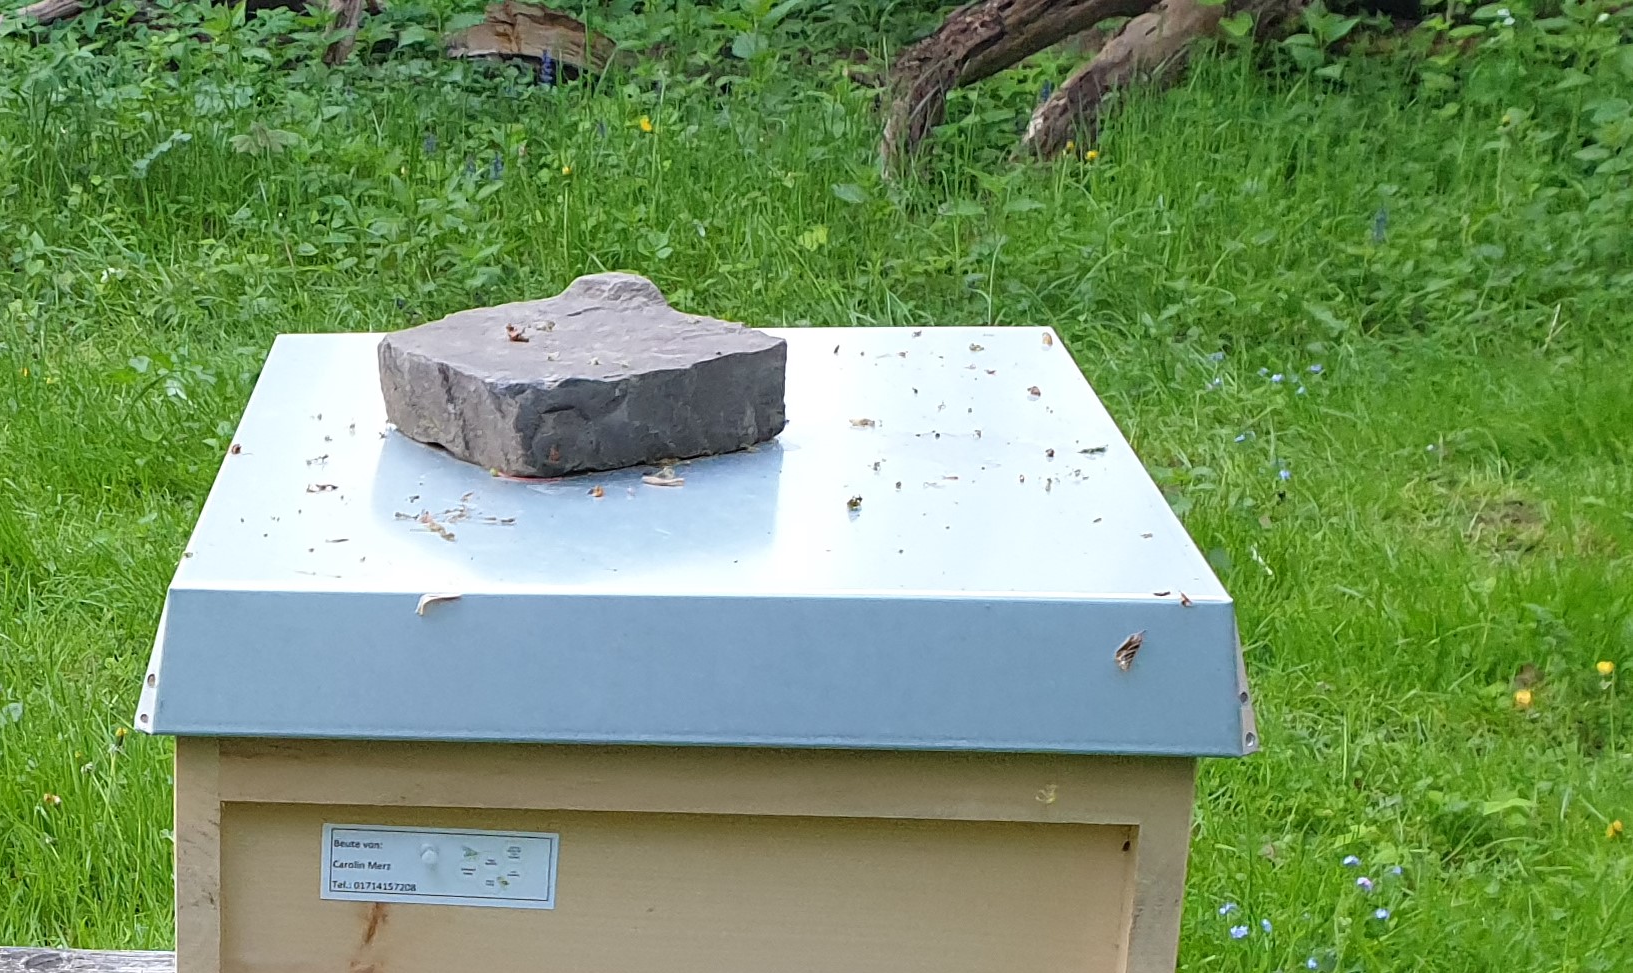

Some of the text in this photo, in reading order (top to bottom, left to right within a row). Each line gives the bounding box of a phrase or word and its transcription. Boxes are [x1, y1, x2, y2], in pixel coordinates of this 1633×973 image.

[333, 839, 361, 849] Beute
[332, 860, 365, 870] Carolin
[353, 881, 417, 892] 01714157208
